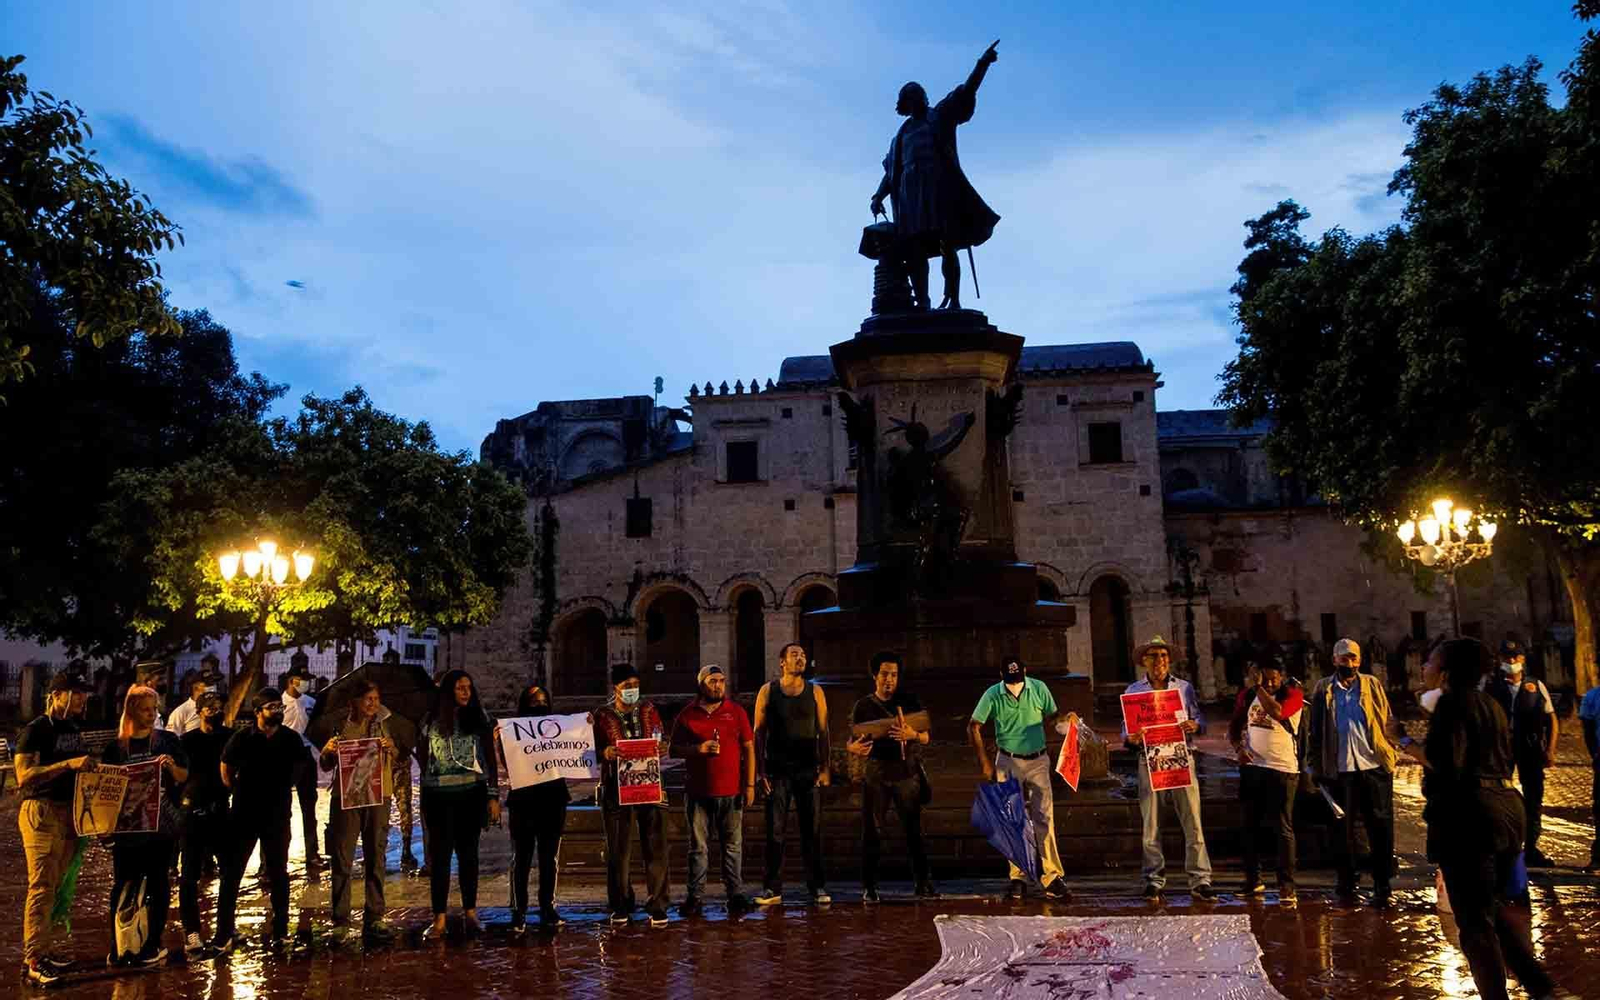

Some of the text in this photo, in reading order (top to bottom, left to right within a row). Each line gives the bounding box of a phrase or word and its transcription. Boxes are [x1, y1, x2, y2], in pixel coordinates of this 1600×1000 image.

[513, 719, 561, 740] NO
[524, 740, 589, 754] celebramos
[535, 757, 593, 774] genocidio
